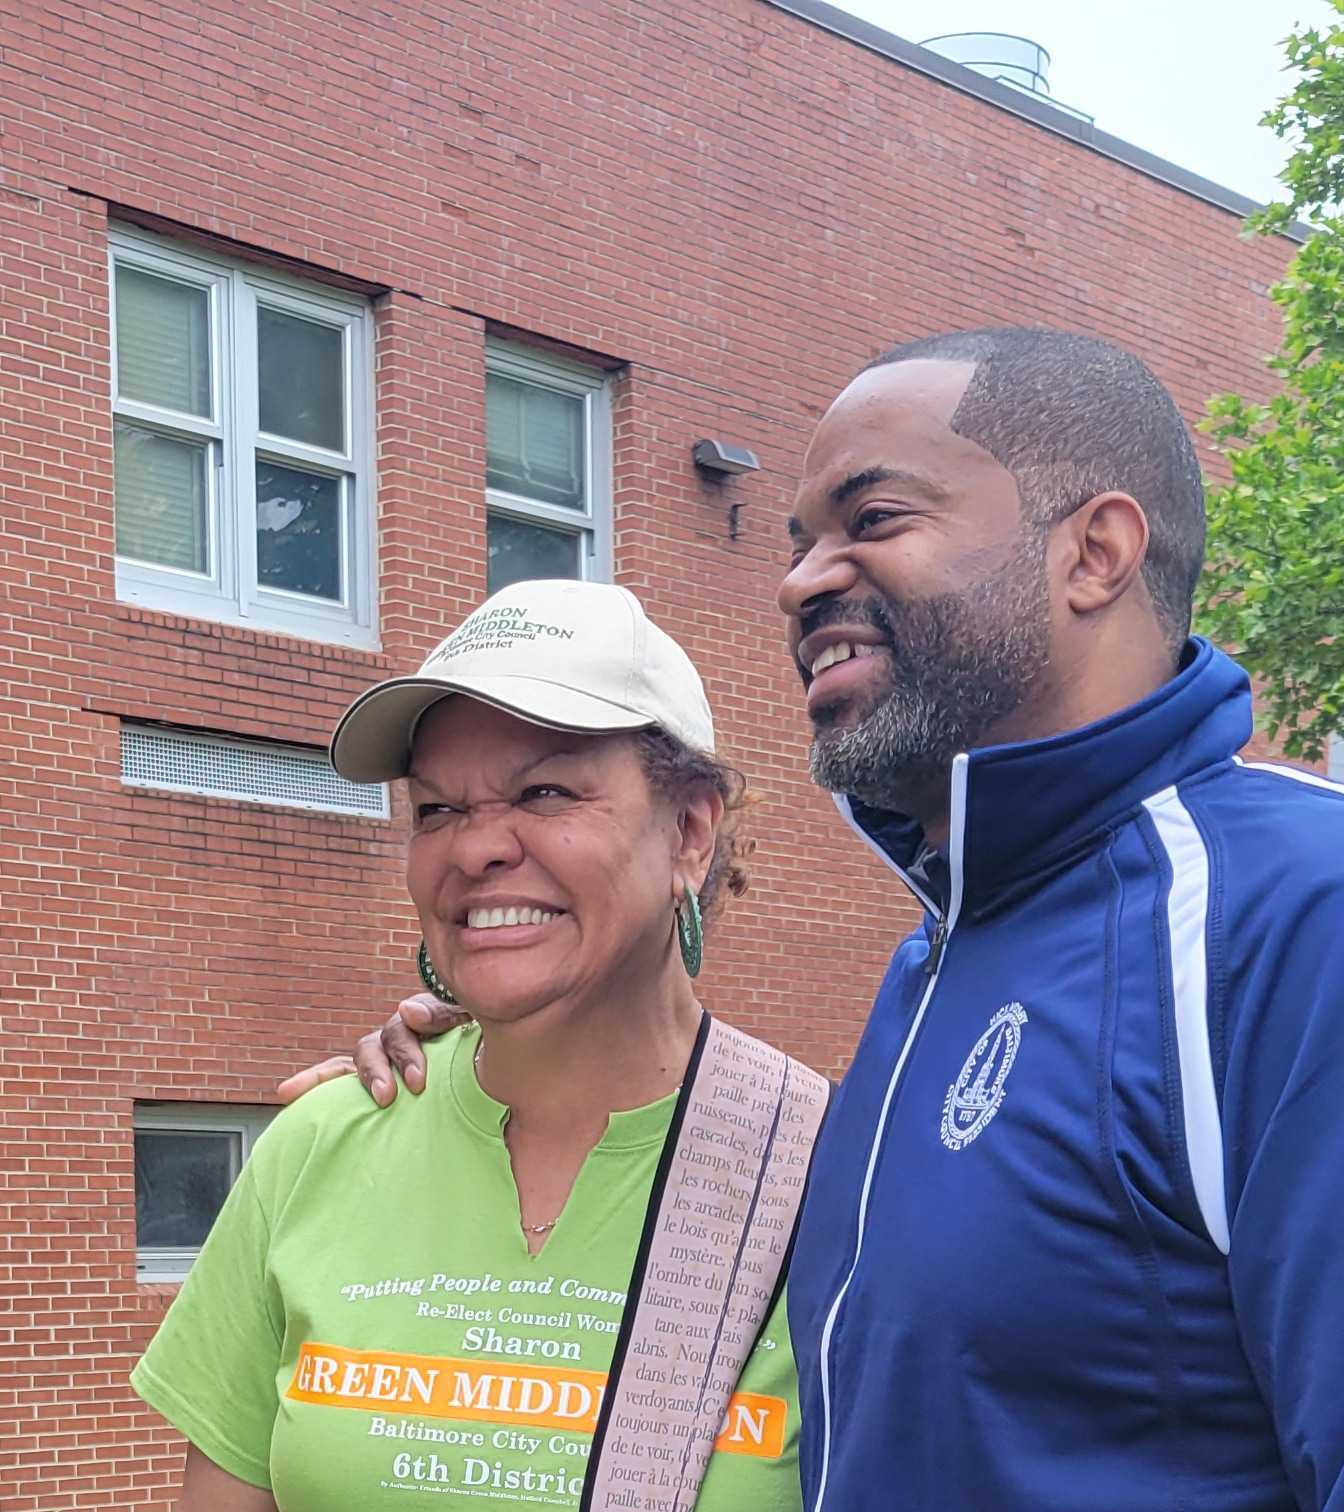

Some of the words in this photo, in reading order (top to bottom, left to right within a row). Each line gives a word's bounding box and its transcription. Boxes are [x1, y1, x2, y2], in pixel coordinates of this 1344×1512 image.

[467, 619, 575, 640] MIDDLETON
[710, 1059, 749, 1083] jouer
[693, 1100, 756, 1135] ruisseaux,
[712, 1084, 749, 1107] paille
[751, 1100, 777, 1117] prè
[783, 1108, 805, 1124] des
[690, 1126, 748, 1156] cascades,
[788, 1150, 806, 1166] les
[679, 1144, 731, 1172] champs
[781, 1174, 804, 1190] sur
[680, 1168, 698, 1189] les
[759, 1194, 790, 1209] sous
[672, 1191, 691, 1211] les
[752, 1212, 785, 1232] dans
[663, 1214, 677, 1234] le
[680, 1217, 707, 1240] bois
[768, 1236, 782, 1256] le
[668, 1245, 726, 1267] mystère.
[430, 1273, 501, 1296] People
[509, 1276, 554, 1296] and
[647, 1261, 702, 1288] l'ombre
[705, 1272, 724, 1292] du
[416, 1301, 494, 1322] Re-Elect
[498, 1307, 571, 1329] Council
[644, 1286, 686, 1312] litaire,
[688, 1300, 721, 1317] sous
[461, 1325, 582, 1361] Sharon
[654, 1317, 685, 1336] tane
[685, 1323, 711, 1341] aux
[633, 1337, 668, 1359] abris.
[676, 1343, 712, 1365] Nou
[716, 1348, 744, 1373] iron
[297, 1354, 440, 1405] GREEN
[635, 1362, 667, 1384] dans
[669, 1367, 688, 1387] les
[368, 1417, 485, 1446] Baltimore
[493, 1430, 542, 1455] City
[615, 1413, 669, 1435] toujours
[672, 1422, 690, 1438] un
[610, 1435, 628, 1455] de
[631, 1441, 644, 1457] te
[647, 1443, 674, 1463] voir,
[393, 1452, 449, 1483] 6th
[608, 1462, 646, 1482] jouer
[659, 1467, 671, 1486] la
[605, 1488, 641, 1509] paille
